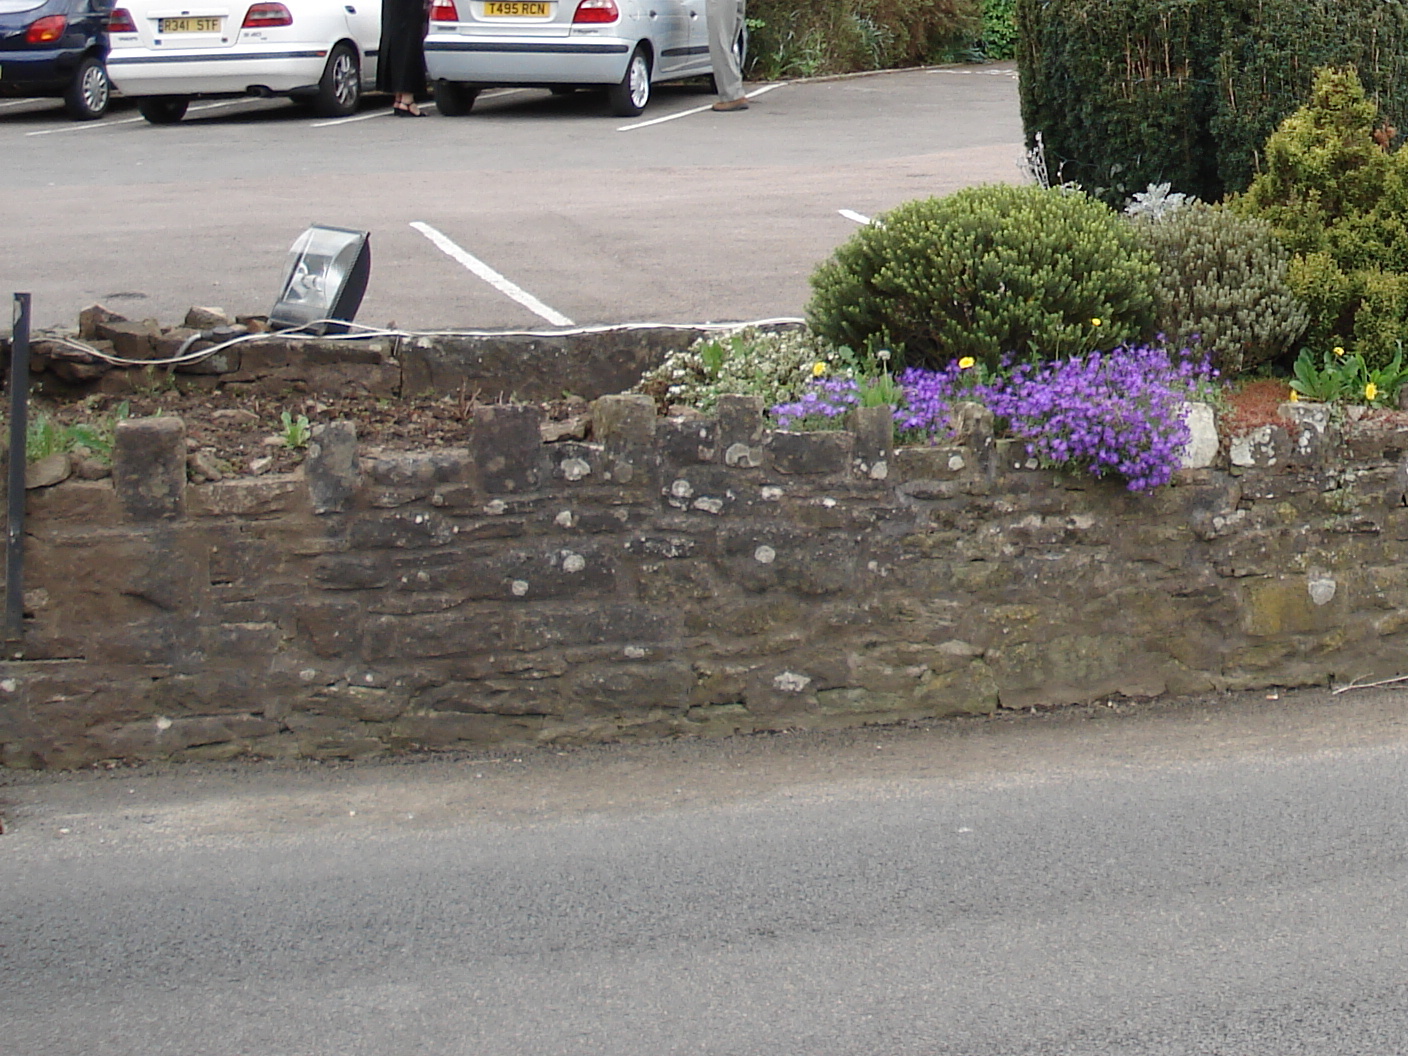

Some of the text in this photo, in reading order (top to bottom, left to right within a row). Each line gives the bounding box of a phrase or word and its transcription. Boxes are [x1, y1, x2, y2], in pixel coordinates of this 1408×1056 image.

[489, 2, 546, 16] T495 RCN
[164, 18, 219, 32] R341 STF
